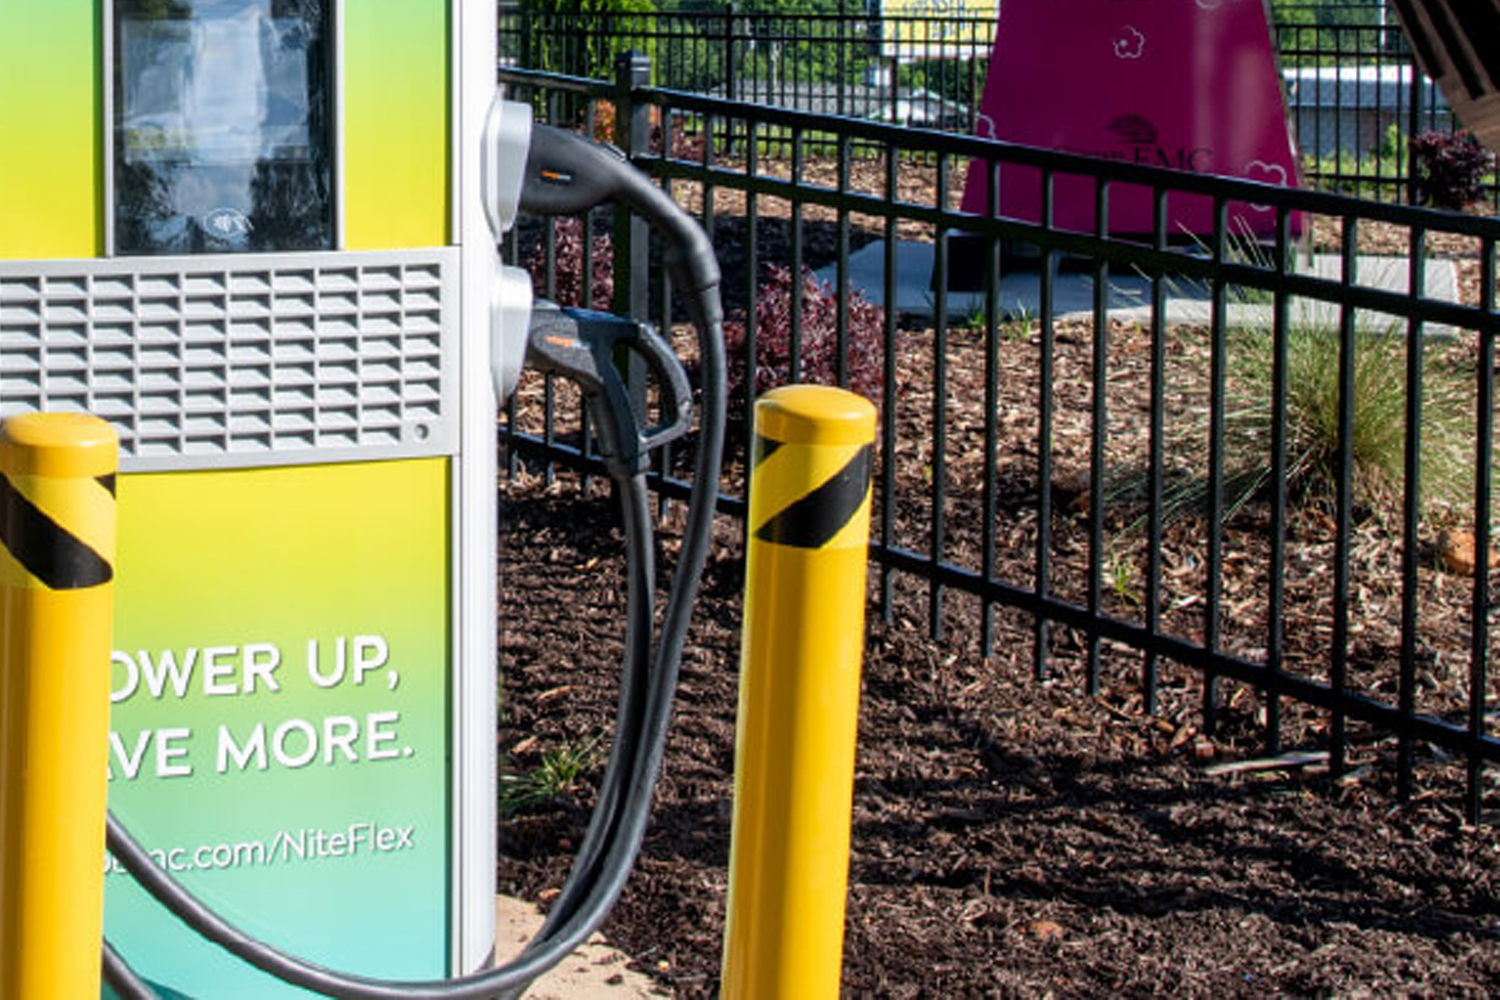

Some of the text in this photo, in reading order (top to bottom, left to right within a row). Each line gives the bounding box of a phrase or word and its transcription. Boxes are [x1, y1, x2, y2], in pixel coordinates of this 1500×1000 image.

[108, 634, 400, 704] OWER UP,
[106, 709, 416, 782] VE MORE.
